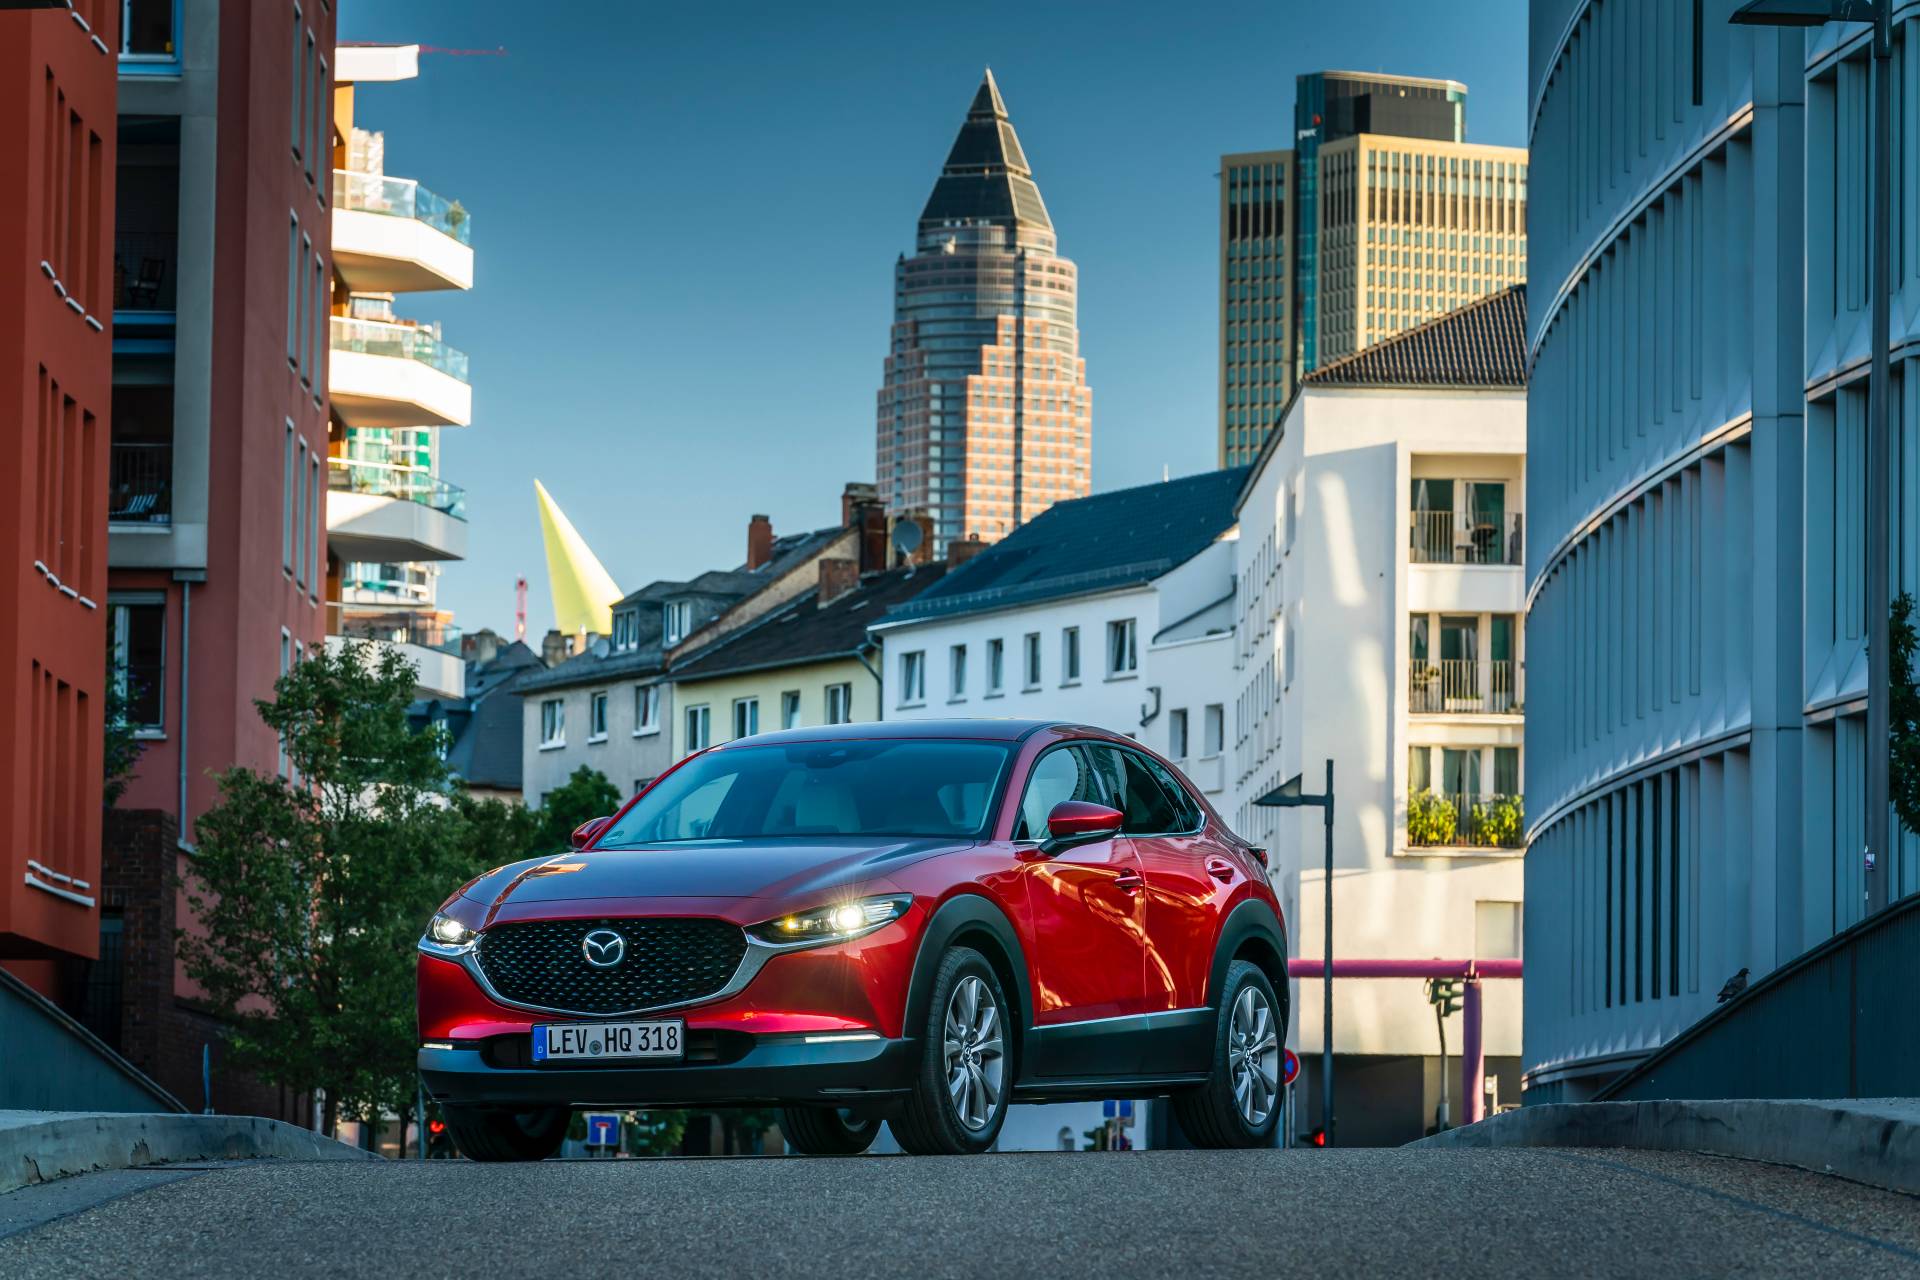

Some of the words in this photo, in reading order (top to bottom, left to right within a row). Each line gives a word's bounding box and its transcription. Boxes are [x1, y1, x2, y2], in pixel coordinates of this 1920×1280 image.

[548, 1029, 588, 1054] LEV
[604, 1027, 632, 1053] HQ
[638, 1026, 678, 1051] 318
[538, 1046, 544, 1054] D
